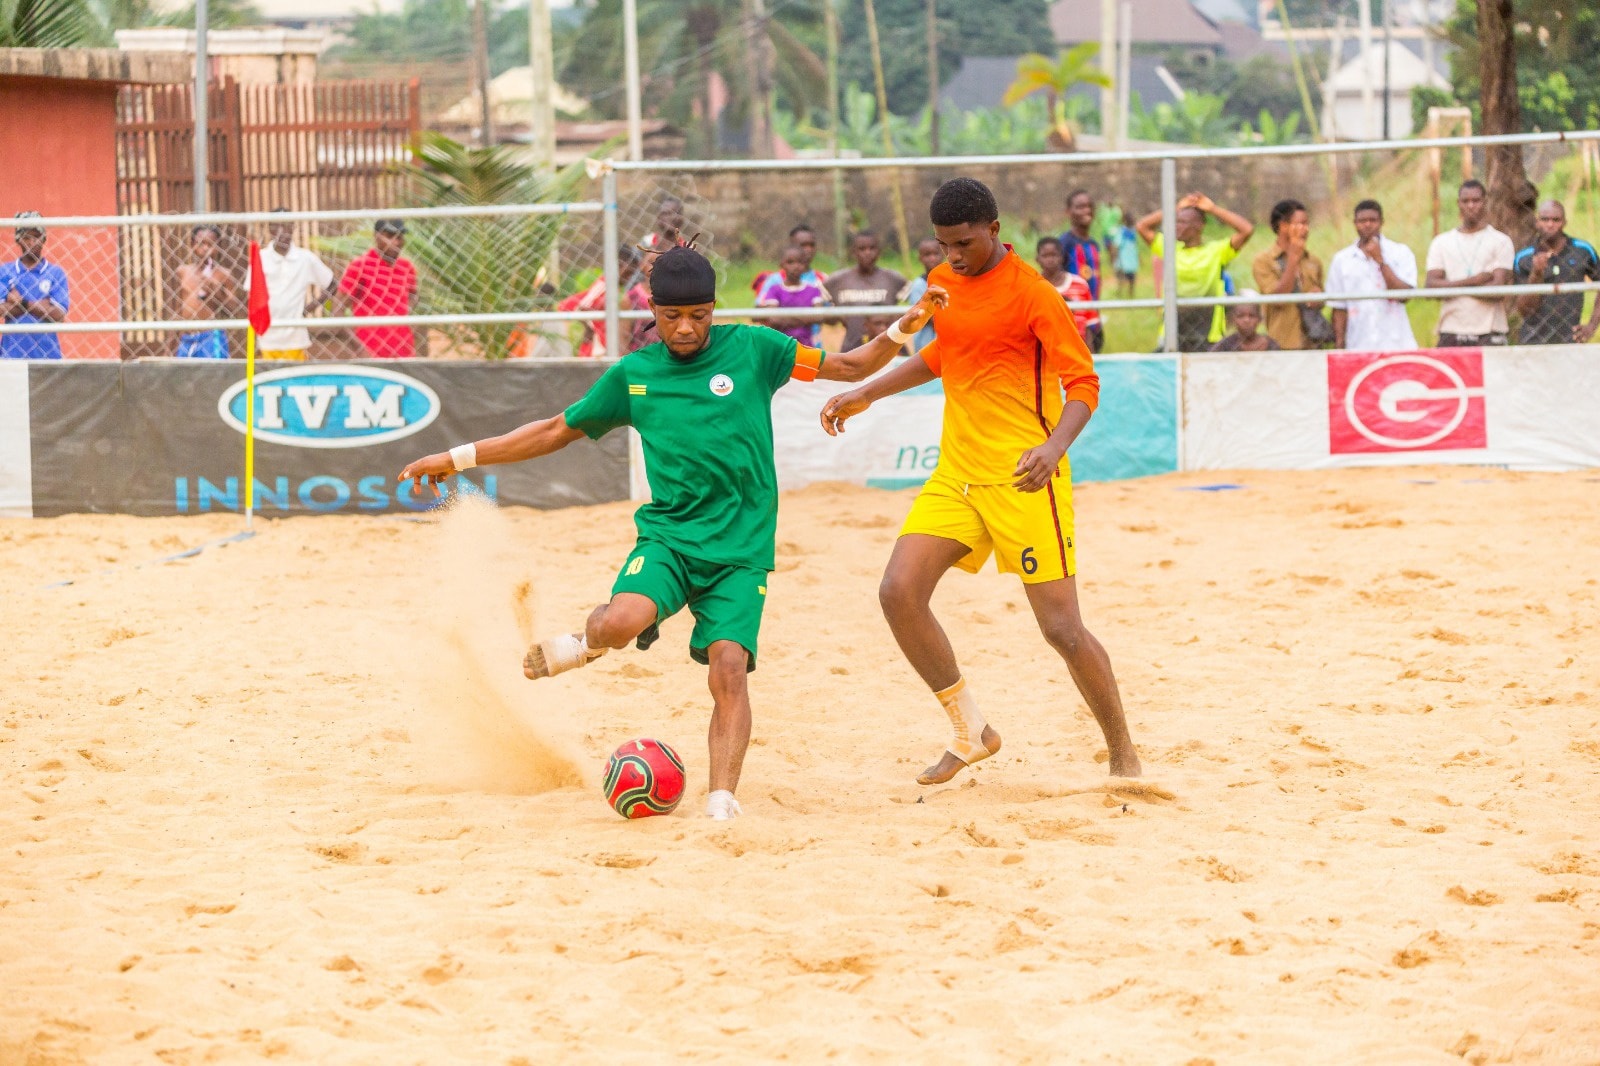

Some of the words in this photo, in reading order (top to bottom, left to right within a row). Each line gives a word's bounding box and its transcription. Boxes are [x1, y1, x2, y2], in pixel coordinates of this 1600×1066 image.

[257, 384, 406, 430] IVM
[625, 556, 645, 576] 10
[1021, 547, 1038, 575] 6
